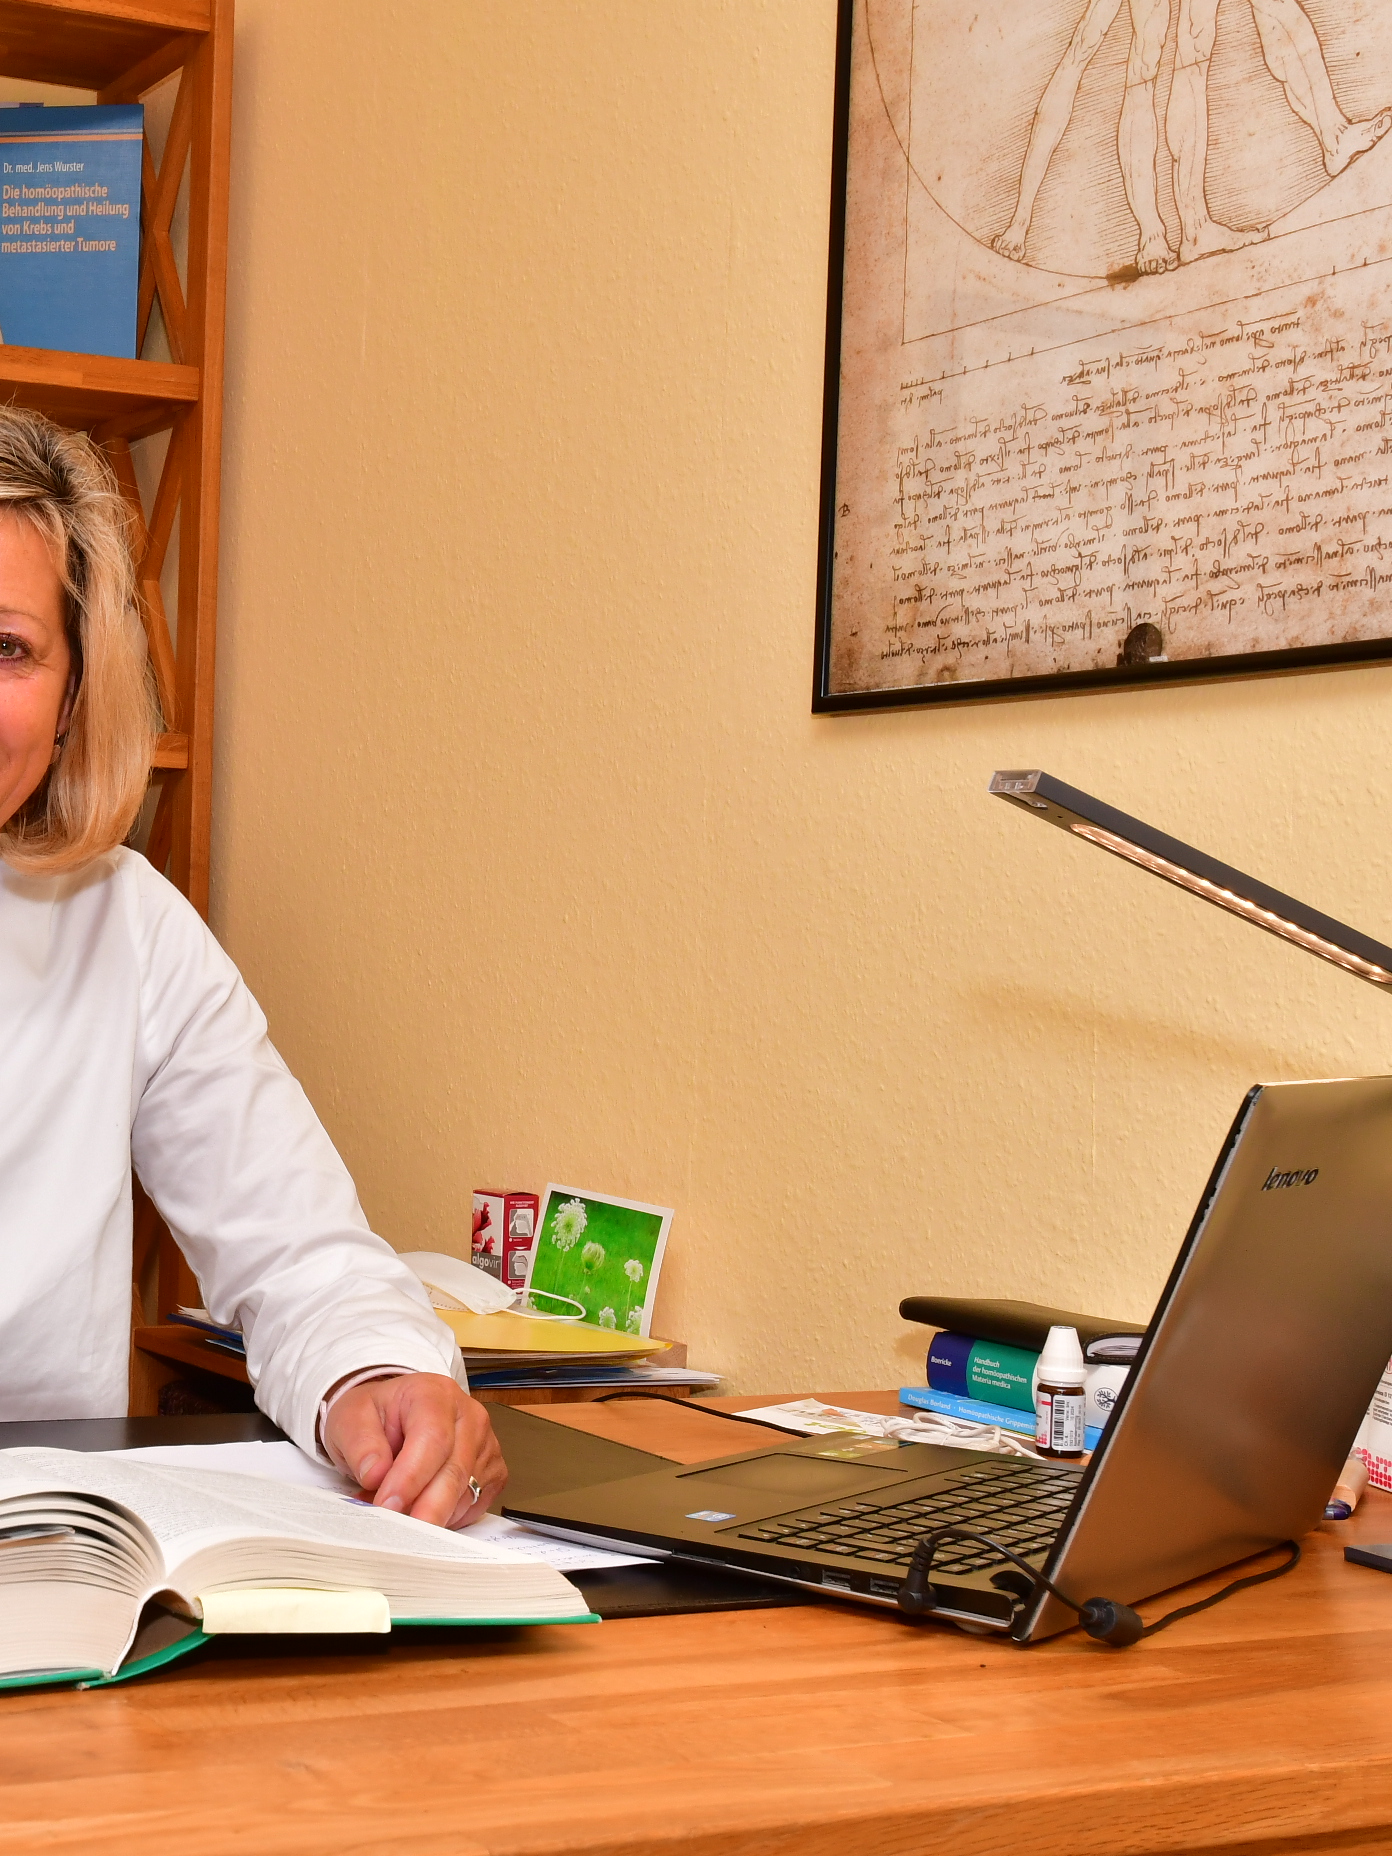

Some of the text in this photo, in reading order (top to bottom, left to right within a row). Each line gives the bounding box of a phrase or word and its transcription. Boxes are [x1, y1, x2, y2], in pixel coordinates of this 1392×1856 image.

[3, 161, 85, 174] Dr. med. Jens Wurster
[2, 183, 108, 202] Die homöopathische
[2, 201, 129, 220] Behandlung und Heilung
[2, 220, 75, 235] von Krebs und
[1, 237, 117, 254] metastasierter Tumore
[1260, 1165, 1319, 1192] lenovo
[472, 1252, 501, 1269] algovir
[930, 1355, 953, 1367] Boericke
[973, 1356, 1001, 1368] Handbuch
[971, 1374, 1011, 1390] Materia medica
[972, 1365, 1028, 1384] der homöopathischen
[907, 1393, 951, 1411] Douglas Borland
[958, 1405, 1005, 1423] Homöopathische
